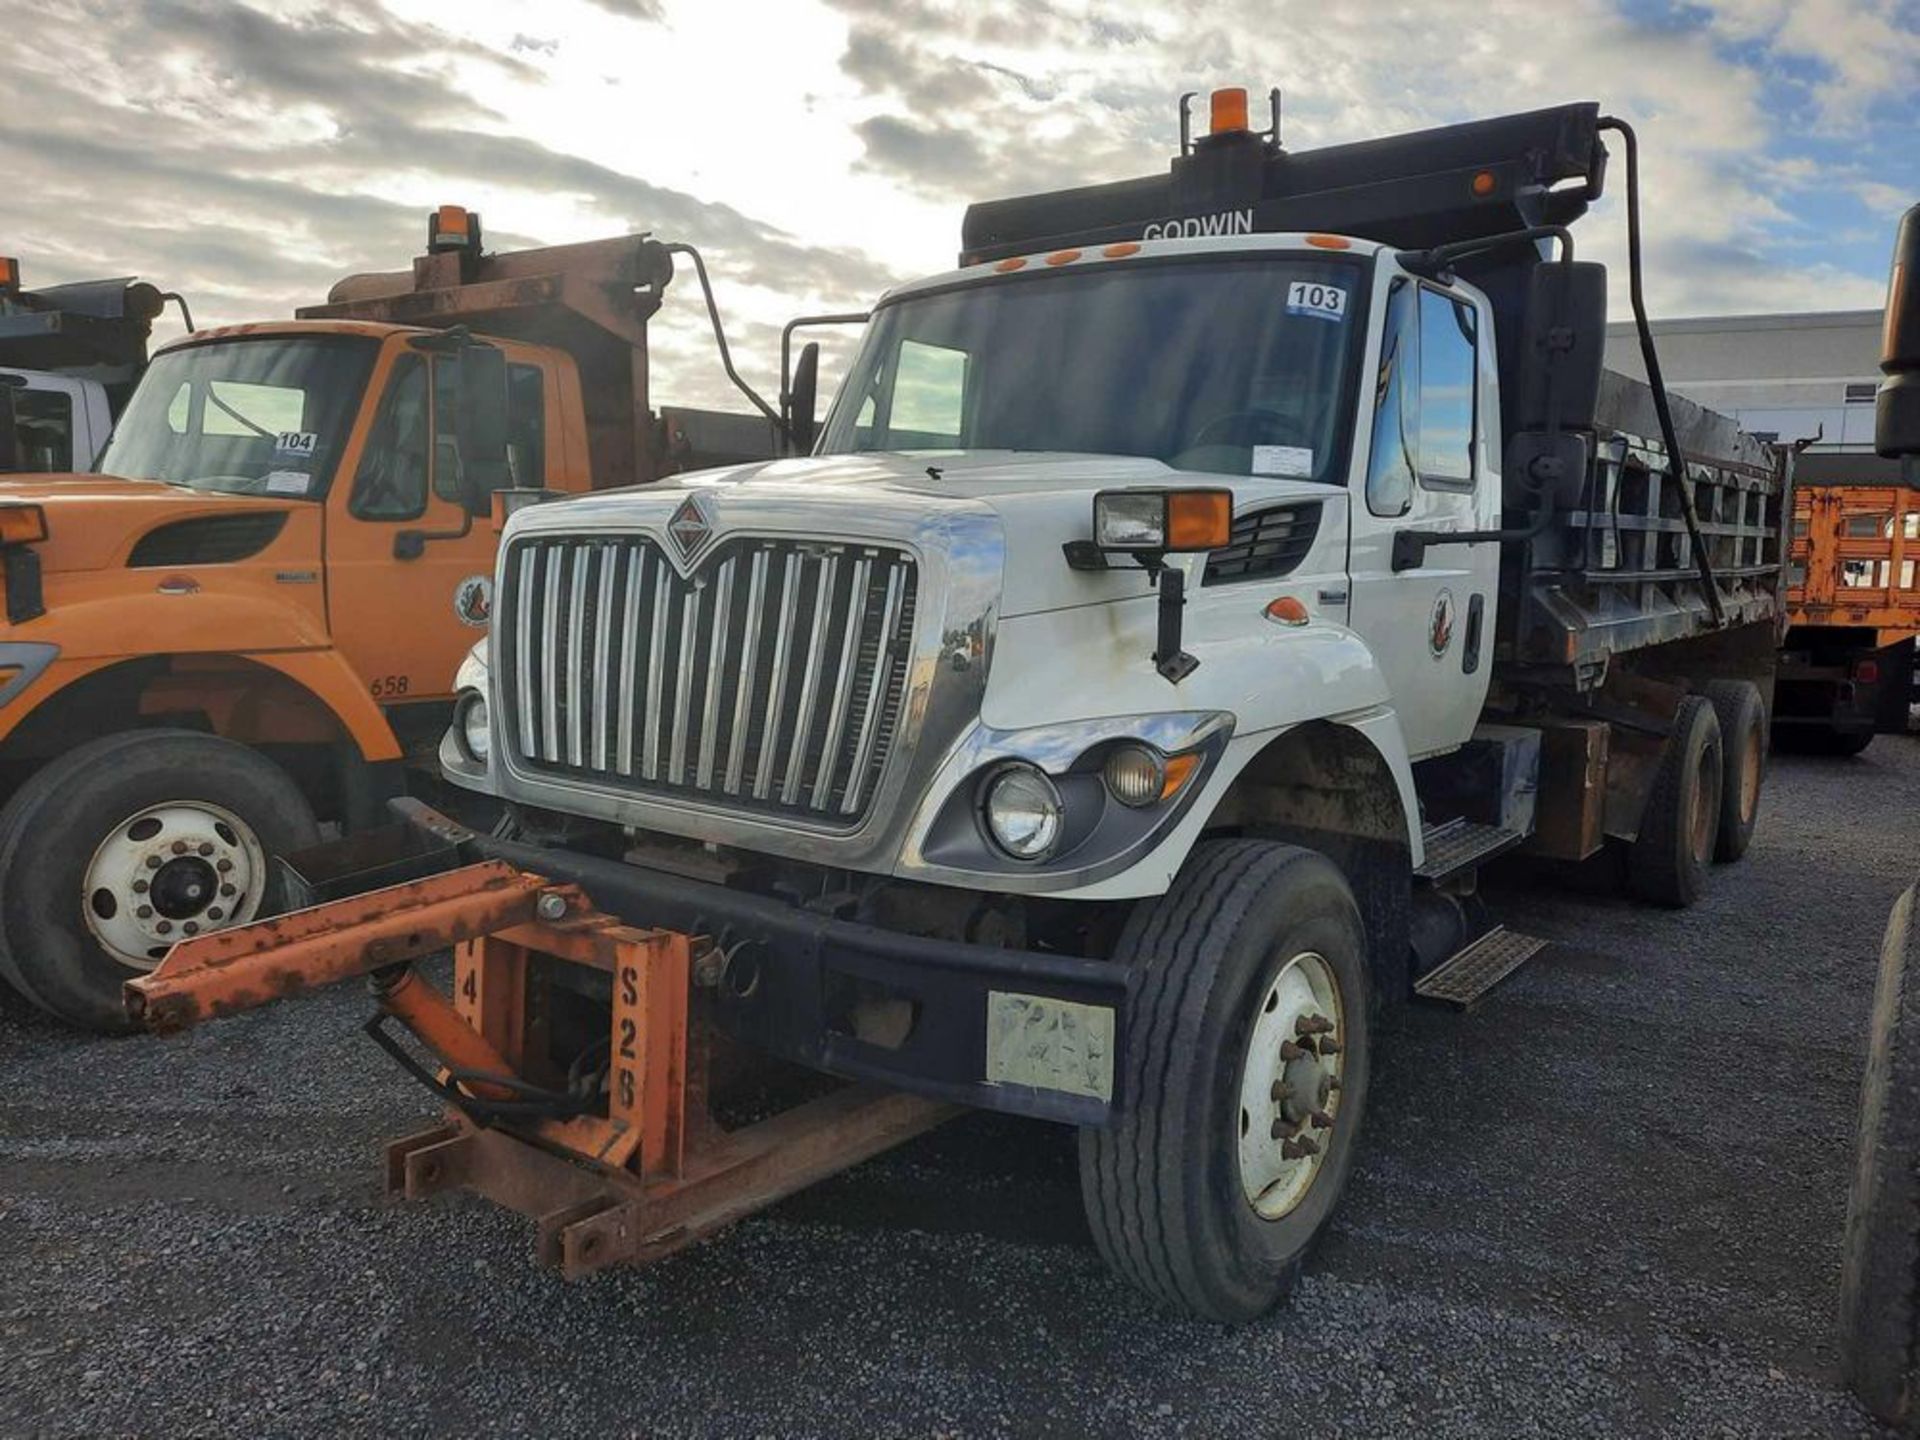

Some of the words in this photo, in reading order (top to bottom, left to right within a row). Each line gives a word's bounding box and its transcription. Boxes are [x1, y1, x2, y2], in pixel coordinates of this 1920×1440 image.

[1143, 208, 1253, 240] GODWIN
[1295, 285, 1340, 310] 103
[281, 433, 312, 450] 104
[370, 675, 408, 696] 658
